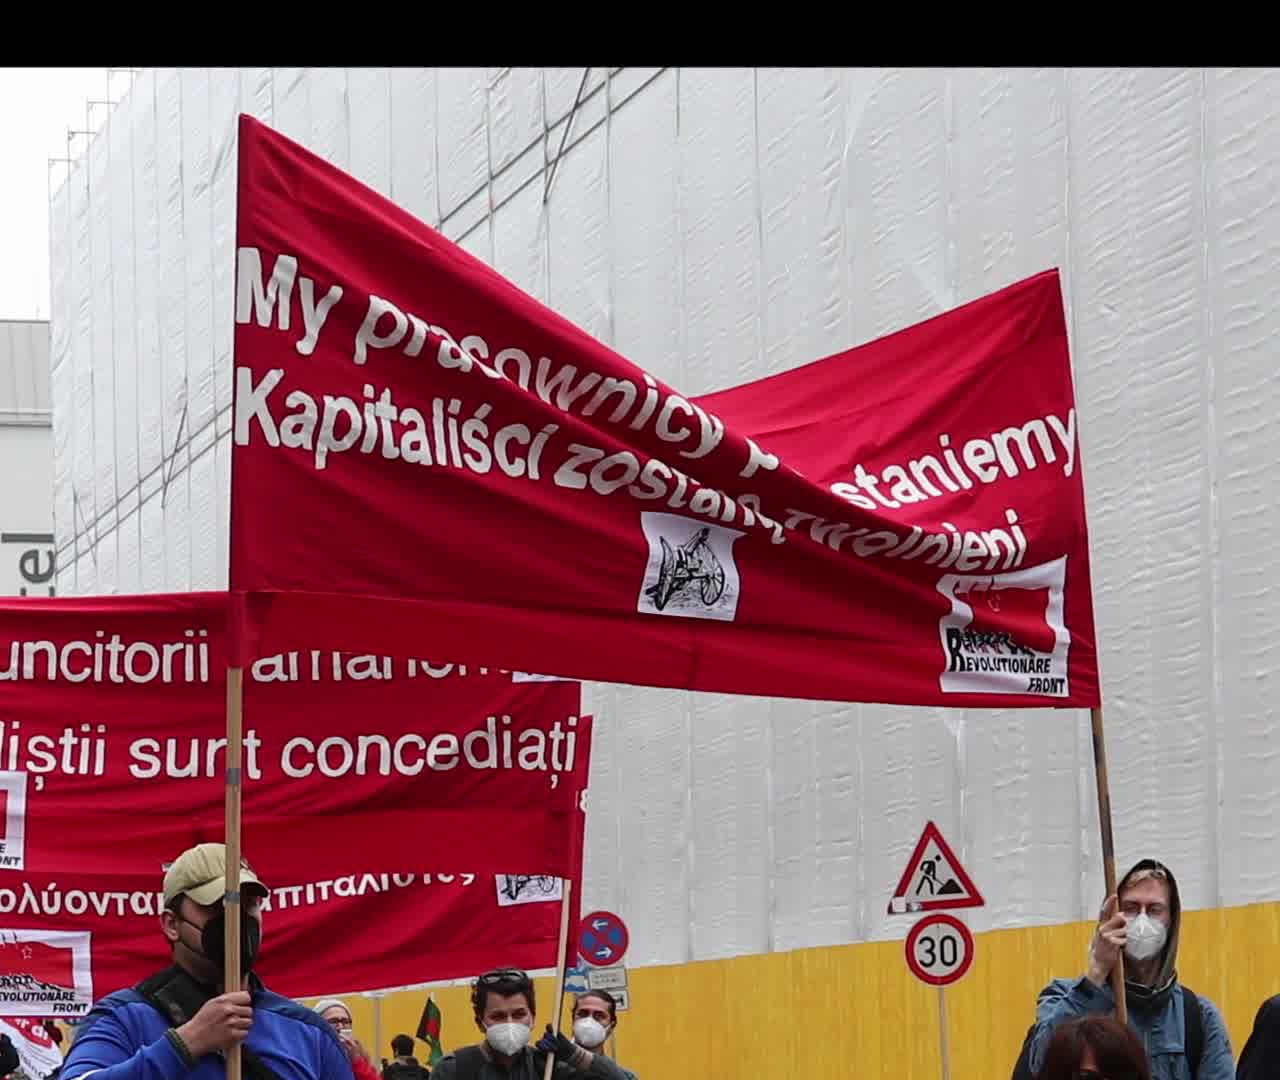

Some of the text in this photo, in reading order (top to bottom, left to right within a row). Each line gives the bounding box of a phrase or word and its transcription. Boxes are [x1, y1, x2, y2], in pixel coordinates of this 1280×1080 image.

[234, 247, 343, 356] My
[1, 533, 55, 597] el
[1027, 677, 1065, 693] FRONT
[919, 935, 958, 968] 30
[52, 1003, 89, 1013] FRONT
